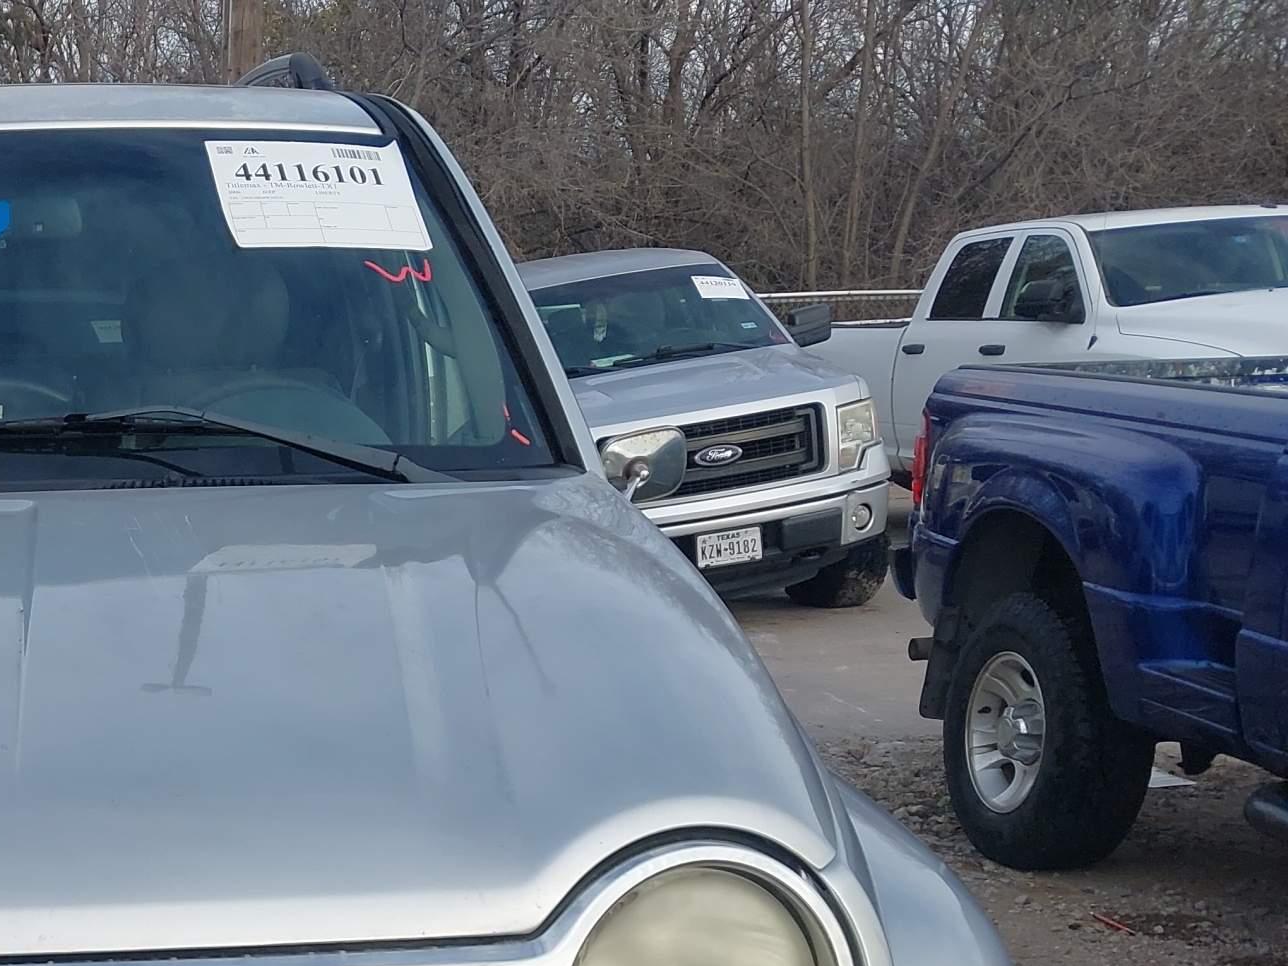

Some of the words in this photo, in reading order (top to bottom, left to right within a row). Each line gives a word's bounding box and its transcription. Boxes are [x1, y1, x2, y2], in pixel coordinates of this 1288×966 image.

[234, 162, 385, 186] 44116101
[717, 532, 740, 541] TEXAS
[701, 538, 758, 560] KZW-9182
